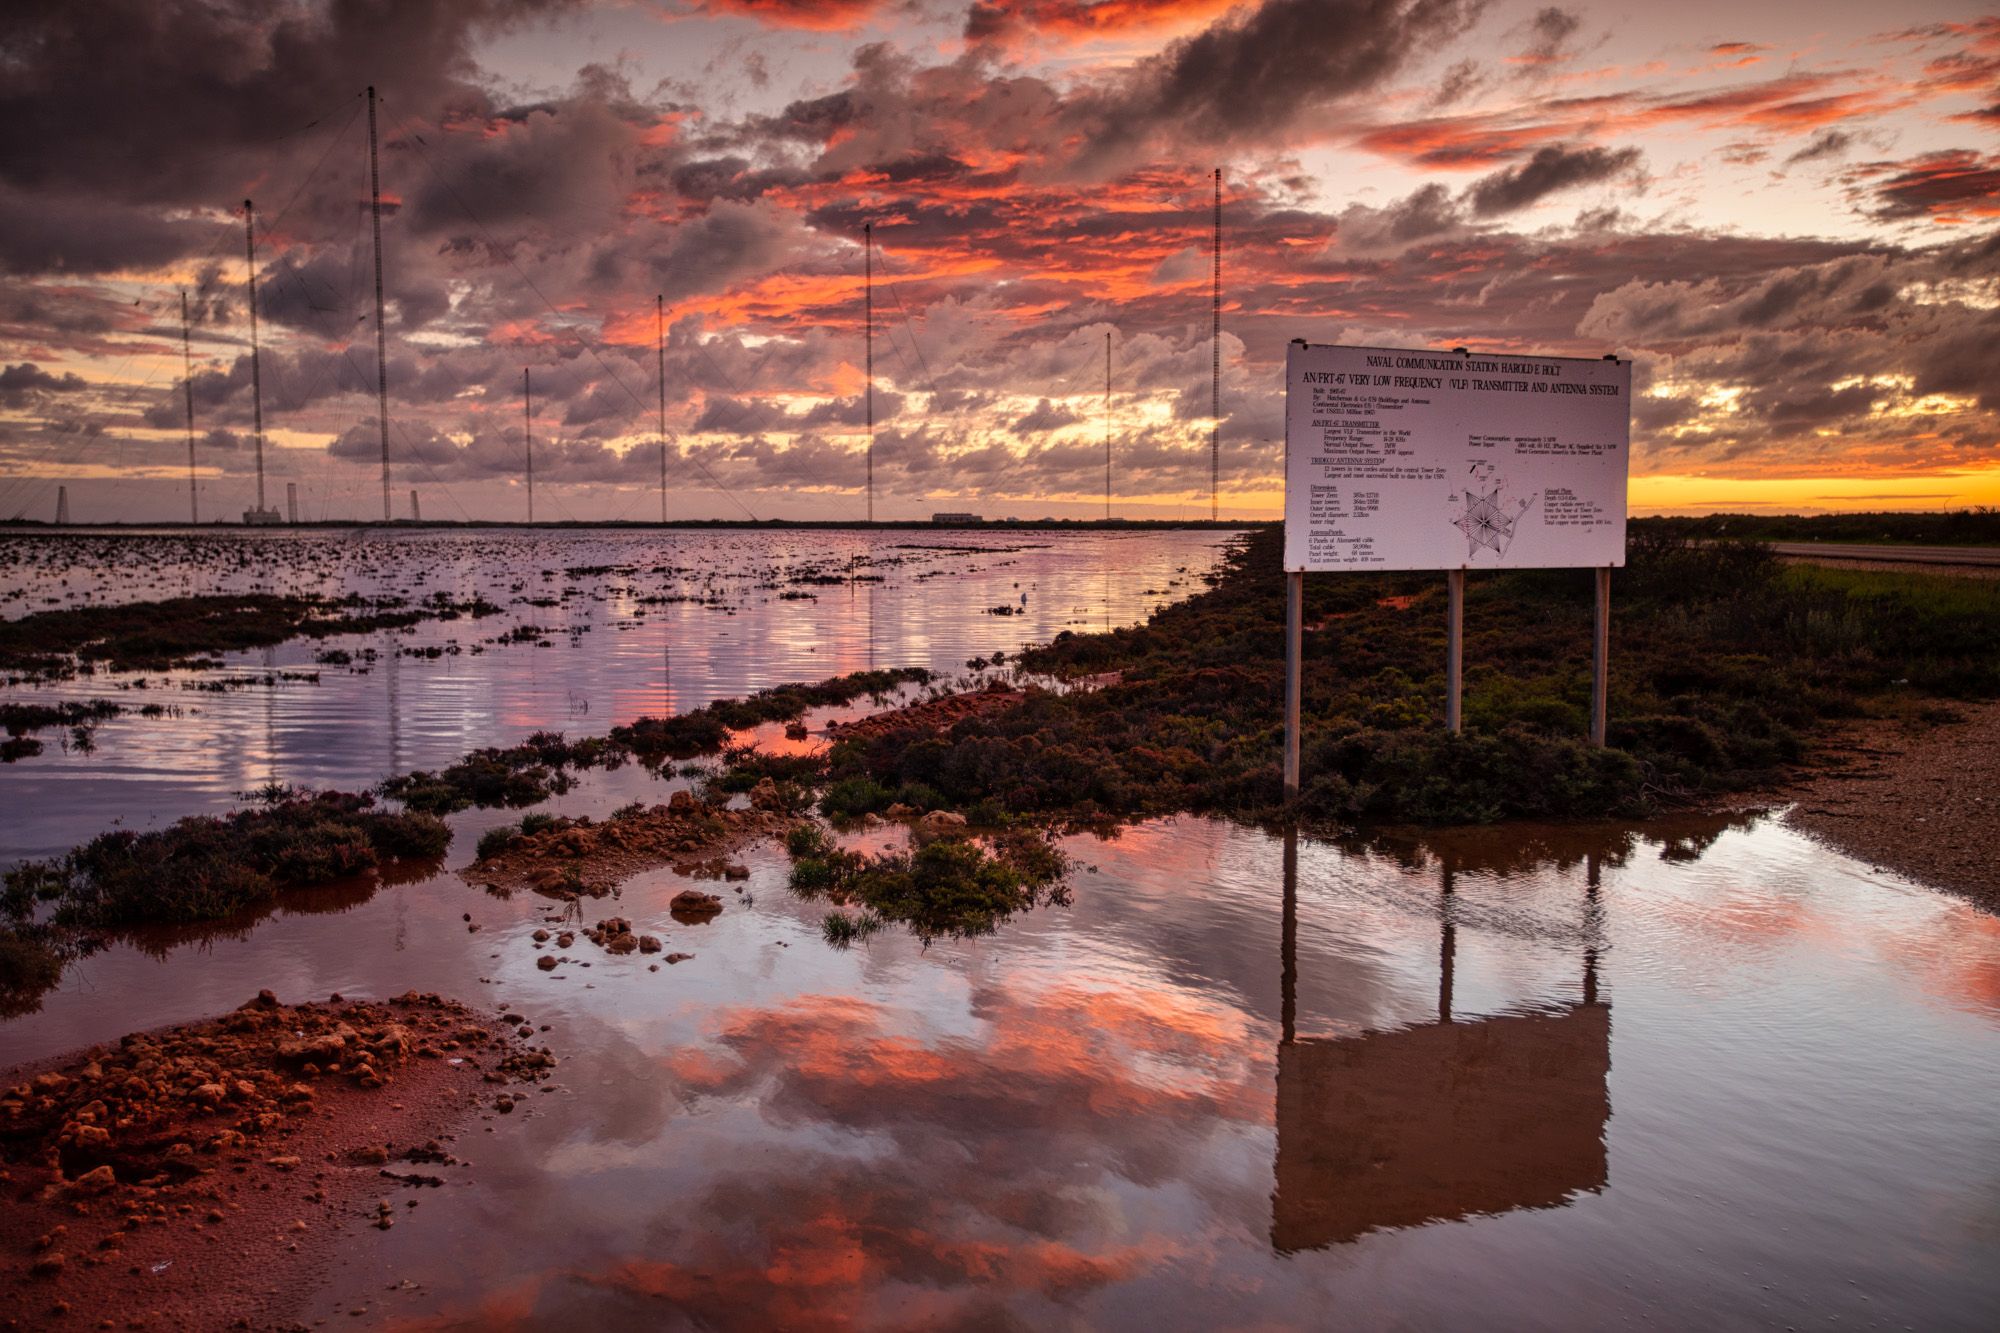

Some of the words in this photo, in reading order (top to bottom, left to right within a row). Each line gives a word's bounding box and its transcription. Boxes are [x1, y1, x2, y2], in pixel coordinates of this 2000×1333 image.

[1367, 356, 1393, 368] NAVAL
[1396, 357, 1463, 371] COMMUNICATION
[1466, 360, 1498, 373] STATION
[1501, 362, 1533, 374] HAROLD
[1535, 364, 1540, 375] E
[1542, 365, 1561, 376] HOLT
[1349, 374, 1370, 386] VERY
[1373, 375, 1391, 386] LOW
[1394, 376, 1442, 389] FREQUENCY
[1449, 379, 1468, 390] (VLF)
[1472, 379, 1528, 392] TRANSMITTER
[1531, 382, 1547, 393] AND
[1550, 383, 1586, 395] ANTENNA
[1589, 384, 1618, 396] SYSTEM
